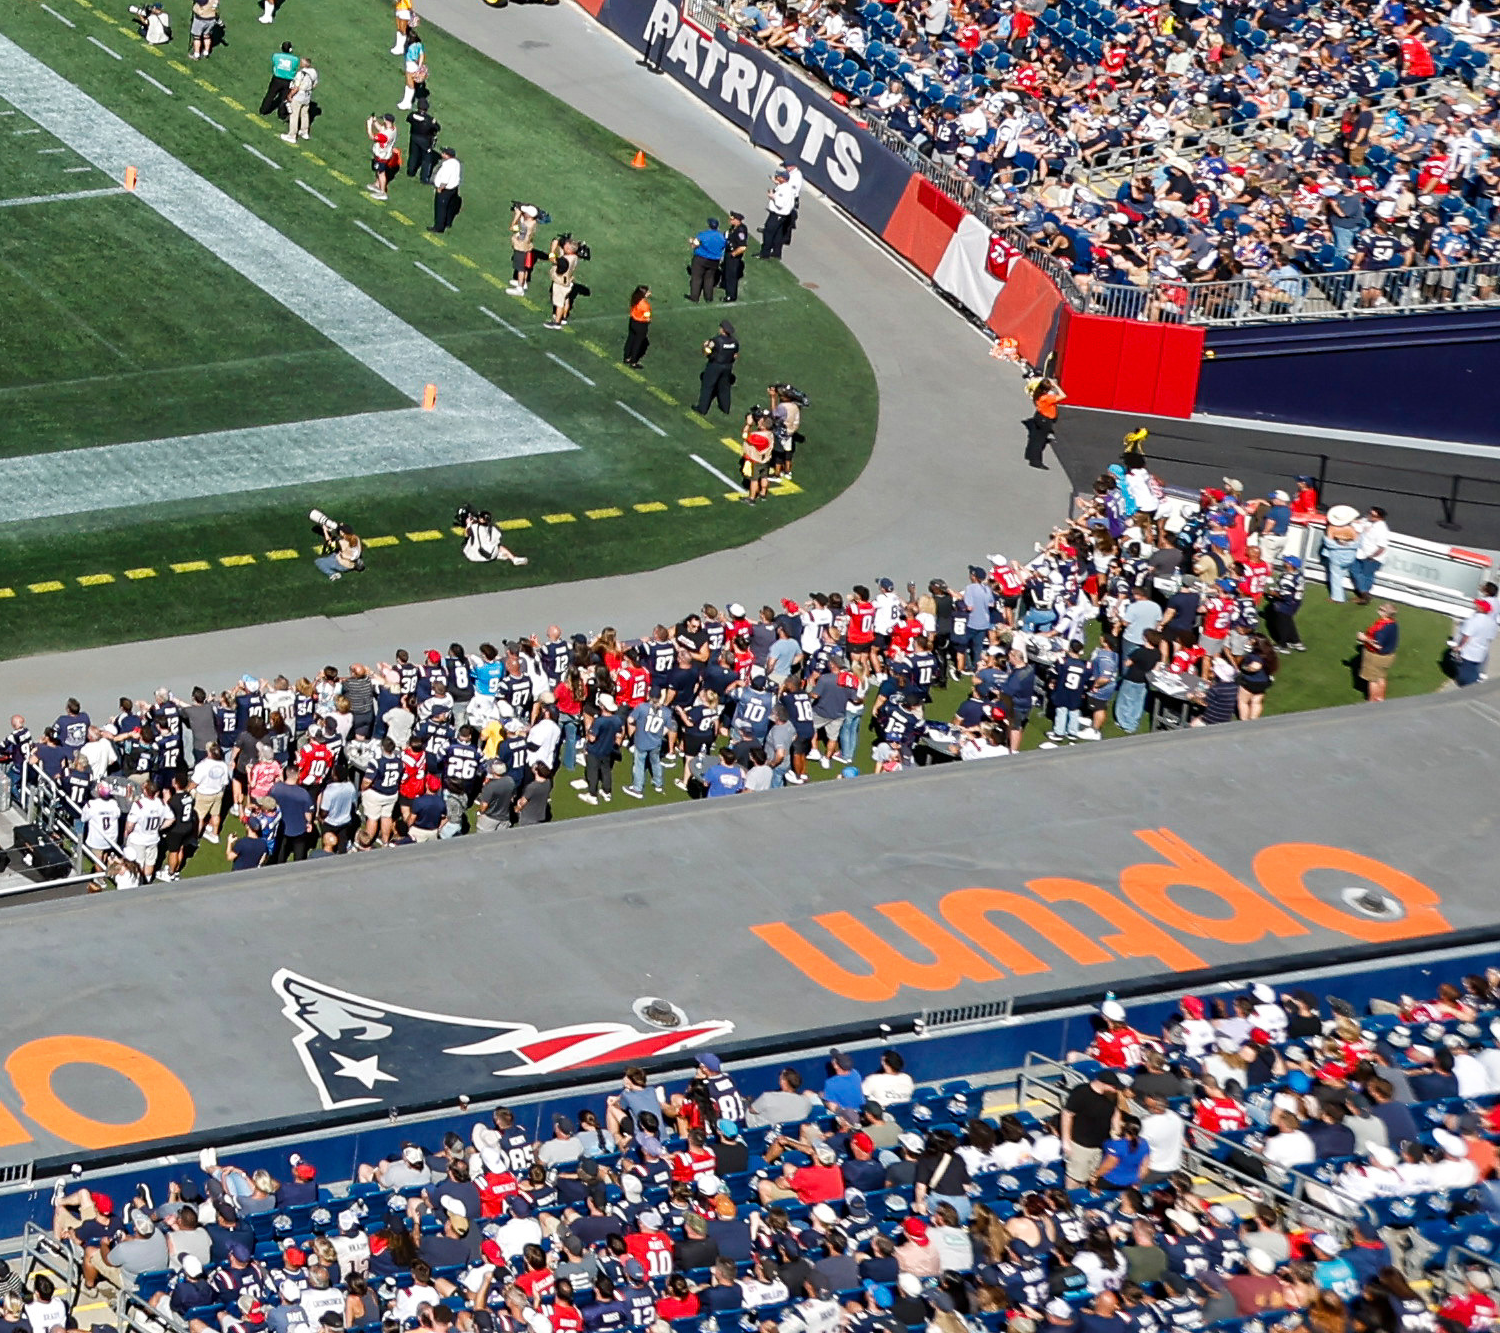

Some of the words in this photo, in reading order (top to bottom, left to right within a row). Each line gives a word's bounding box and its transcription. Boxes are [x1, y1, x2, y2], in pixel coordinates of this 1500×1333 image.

[1065, 673, 1081, 690] 9
[744, 703, 766, 723] 10
[446, 757, 478, 780] 26
[719, 1095, 743, 1121] 81
[646, 1250, 673, 1277] 10
